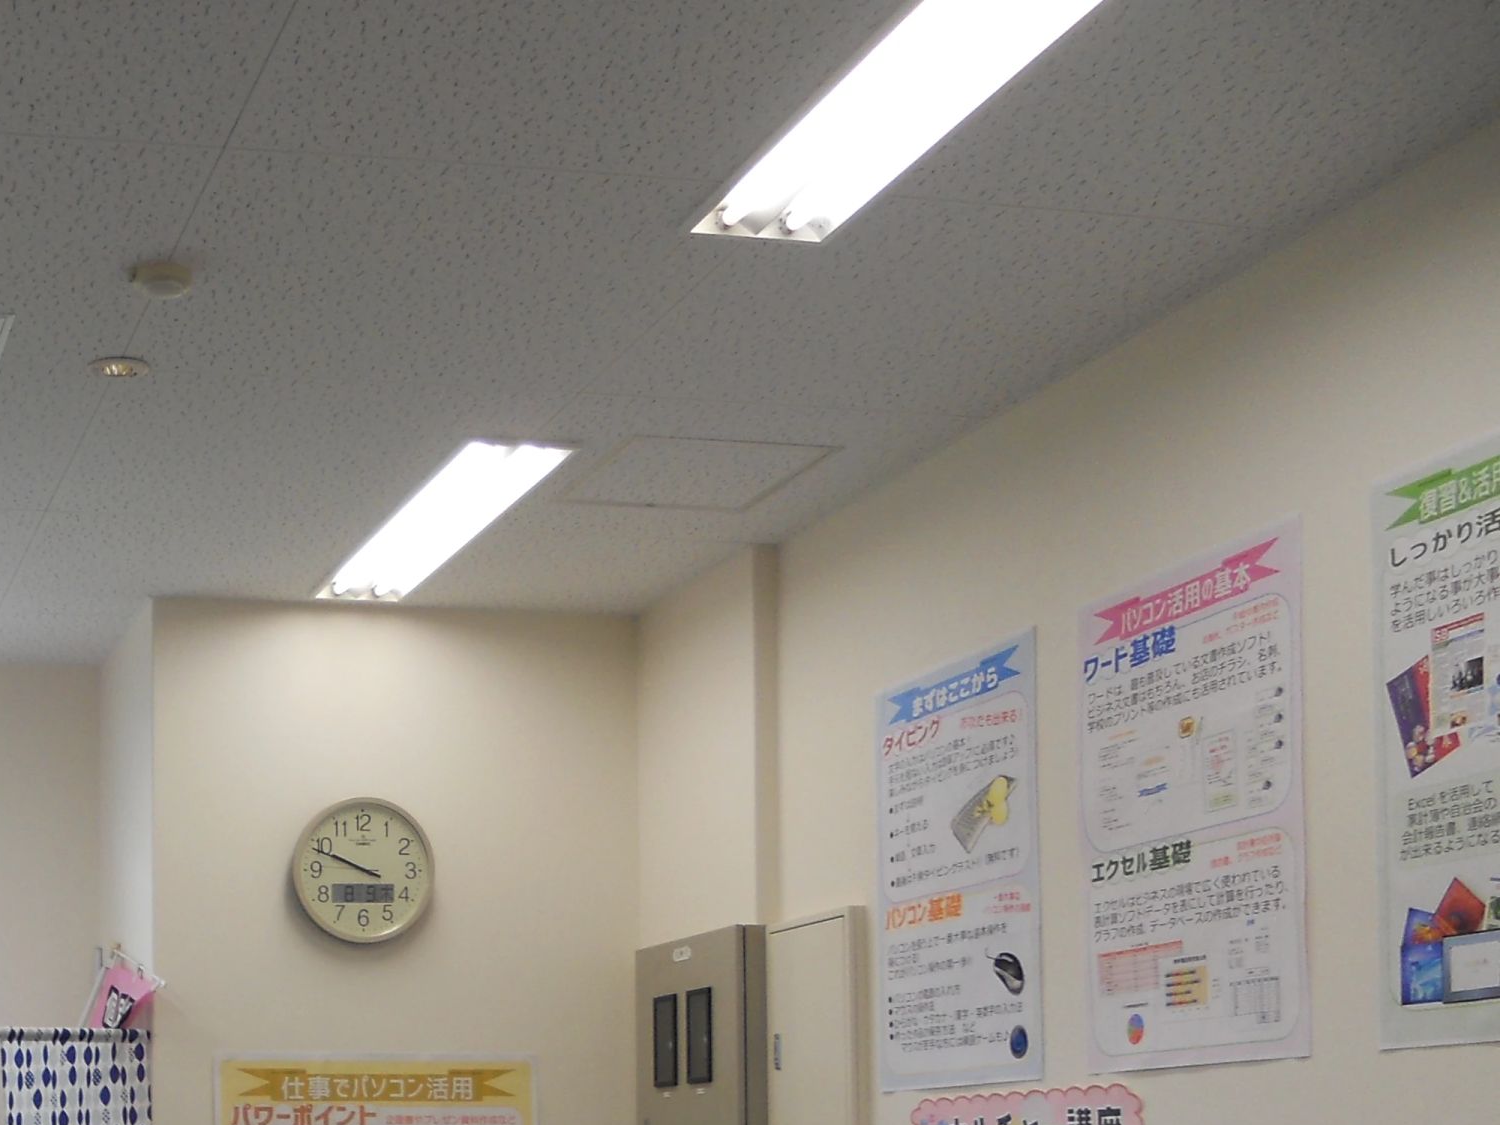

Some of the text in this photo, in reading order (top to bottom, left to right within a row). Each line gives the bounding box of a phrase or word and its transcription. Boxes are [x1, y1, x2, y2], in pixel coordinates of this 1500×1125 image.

[1121, 563, 1251, 635] パソコン活用の基本
[1084, 625, 1176, 683] ワード基礎
[912, 667, 998, 717] まずはここから
[883, 719, 940, 757] タイピング
[334, 820, 347, 837] 11
[355, 814, 372, 832] 12
[384, 820, 389, 838] 1
[316, 837, 333, 855] 10
[398, 838, 411, 856] 2
[310, 861, 323, 879] 9
[1091, 840, 1192, 882] エクセル基礎
[405, 862, 417, 879] 3
[318, 885, 330, 903] 8
[398, 886, 410, 902] 4
[335, 904, 346, 921] 7
[357, 909, 370, 927] 6
[382, 904, 394, 921] 5
[281, 1076, 474, 1100] 仕事でパソコン活用
